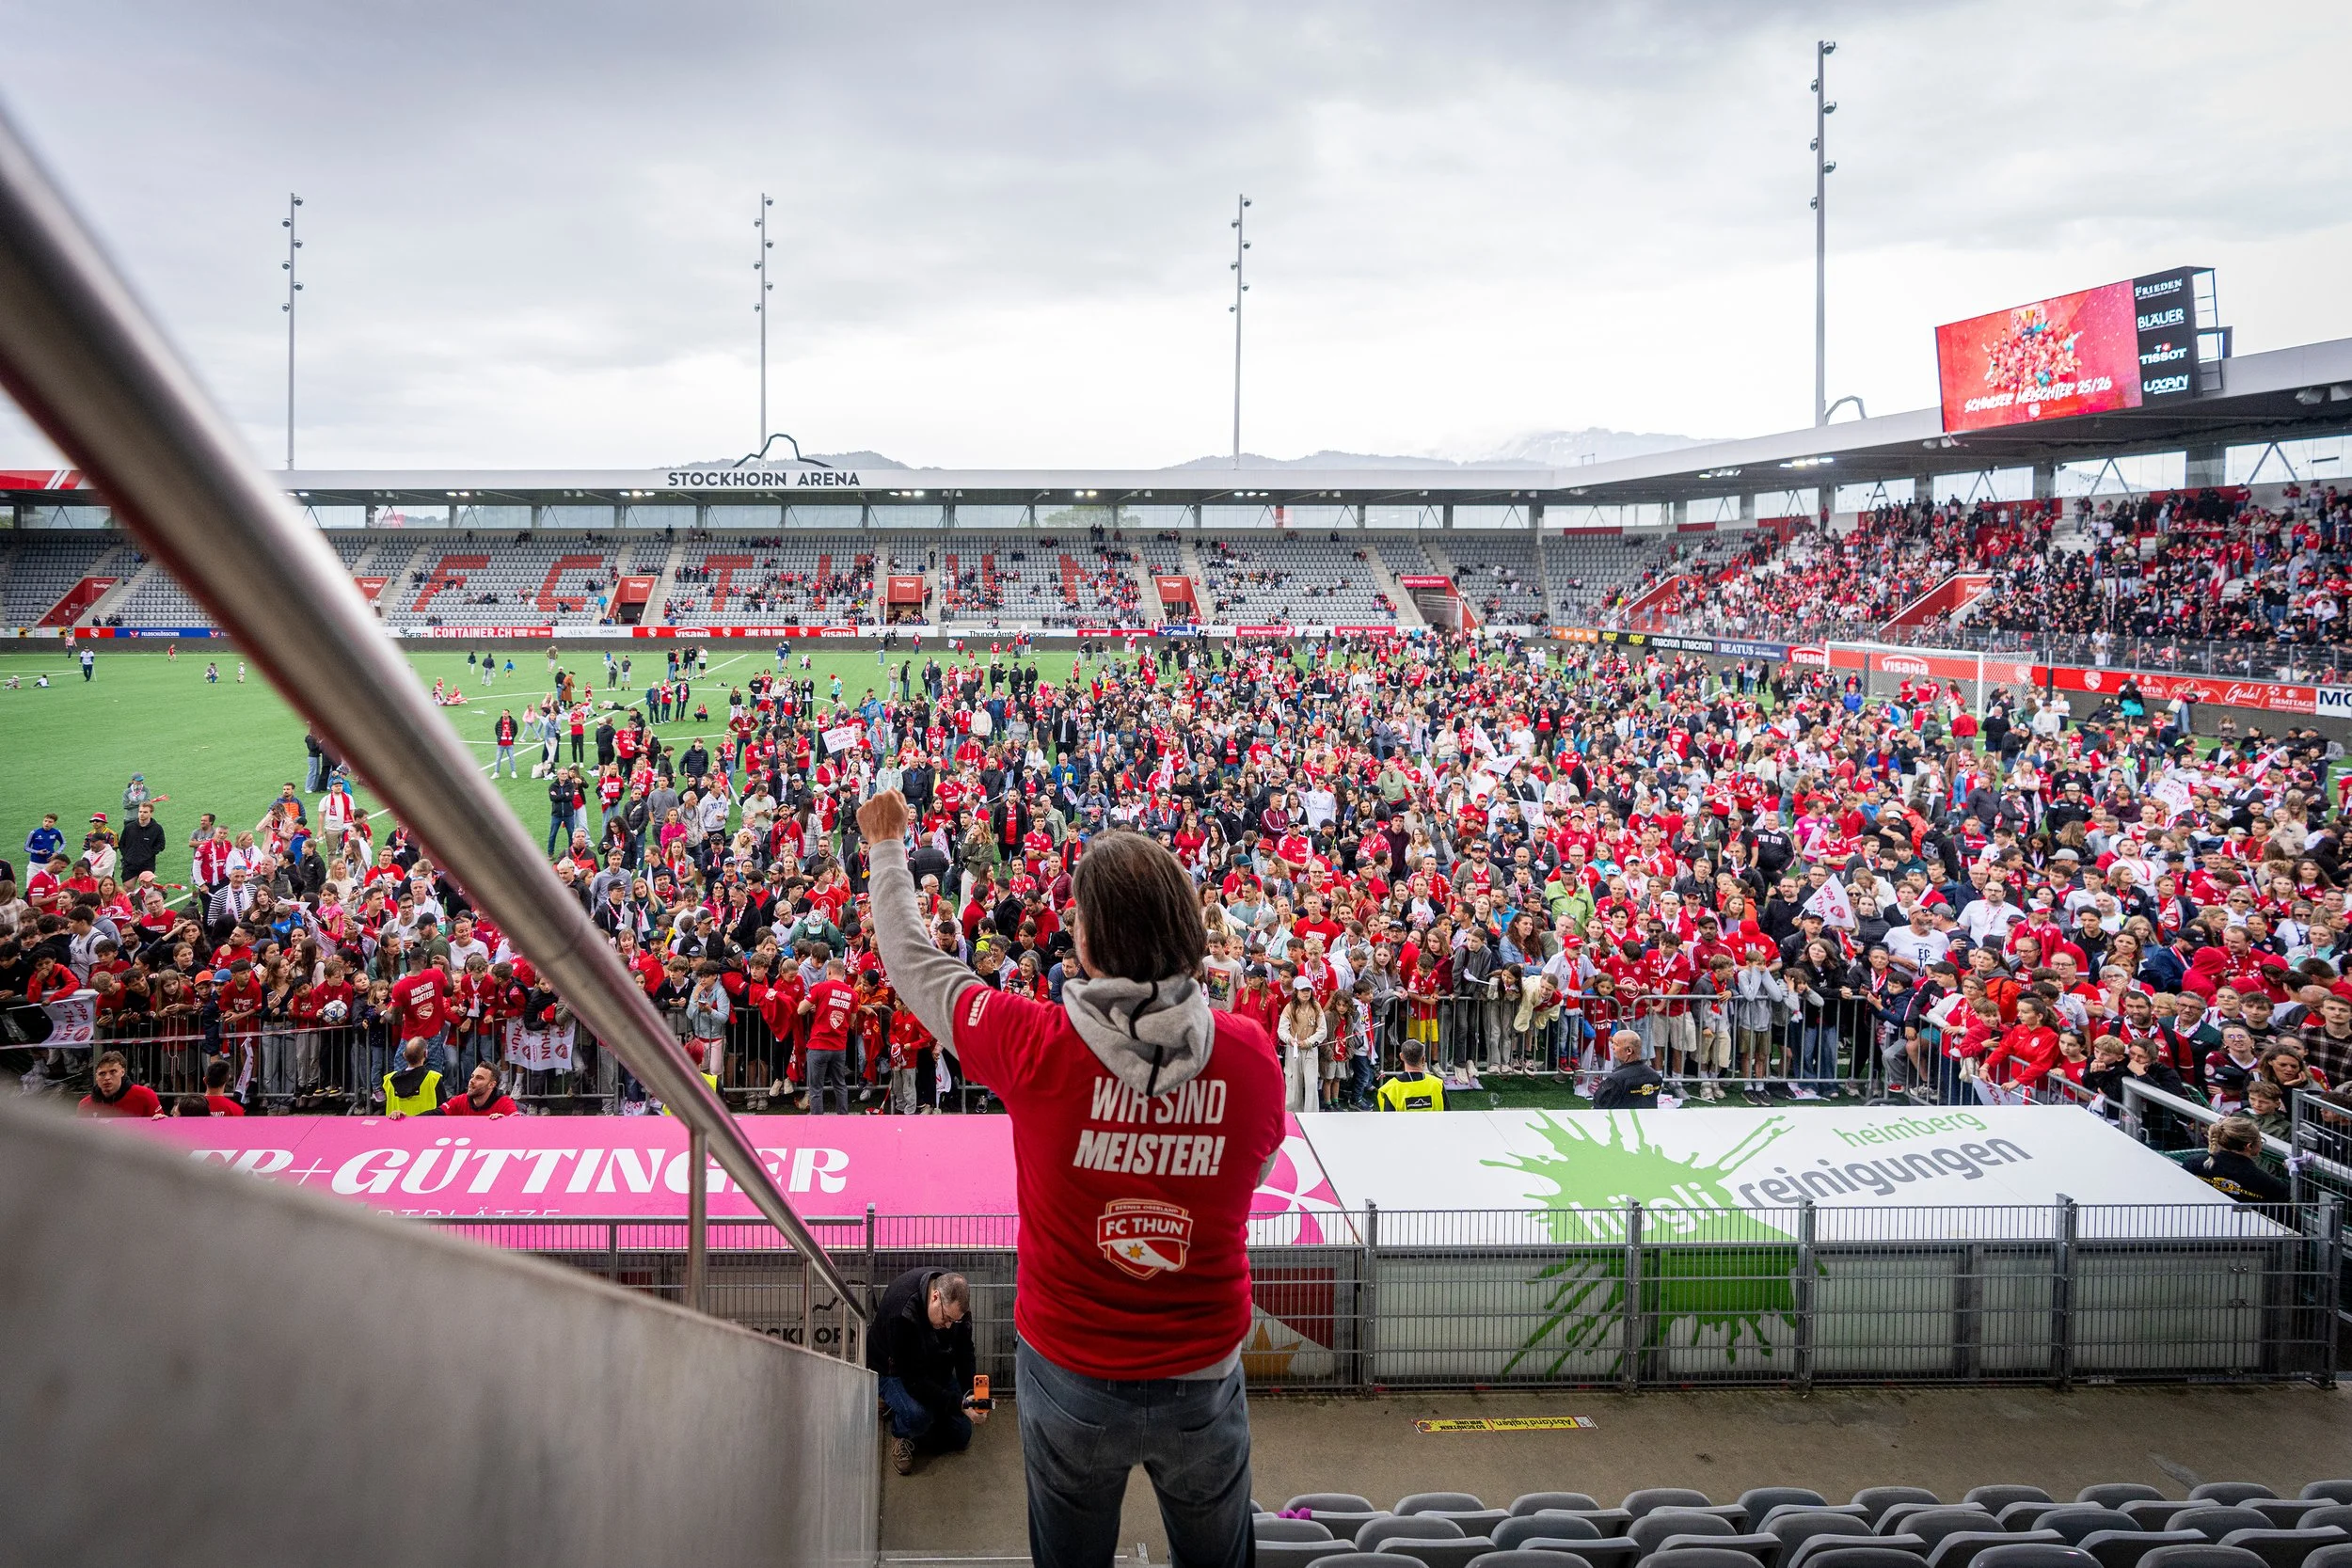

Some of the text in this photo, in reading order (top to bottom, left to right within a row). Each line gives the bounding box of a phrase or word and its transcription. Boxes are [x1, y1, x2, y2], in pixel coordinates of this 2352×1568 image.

[2135, 278, 2182, 297] FRIEDEN
[2137, 308, 2184, 329] BLÄUER
[2139, 347, 2186, 365] TISSOT
[2077, 376, 2112, 395] 25/26
[668, 472, 860, 486] STOCKHORN ARENA
[435, 627, 513, 638] CONTAINER.CH
[1652, 638, 1713, 652] macron macron
[1721, 643, 1754, 656] BEATUS
[1791, 651, 1826, 665] VISAN
[2269, 697, 2315, 707] ERMITAGE
[828, 732, 841, 741] HOPP
[410, 982, 434, 997] WIR SIND
[832, 989, 852, 1001] WIR SIND
[410, 990, 435, 1006] MEISTER!
[828, 998, 851, 1009] MEISTER!
[59, 1010, 75, 1041] THUN
[1091, 1076, 1227, 1124] WIR SIND
[1832, 1112, 1986, 1147] heimberg
[1073, 1130, 1226, 1176] MEISTER!
[1569, 1134, 2033, 1239] hügli reinigungen
[1115, 1204, 1178, 1215] BERNER OBERLAND
[1105, 1217, 1184, 1236] FC THUN
